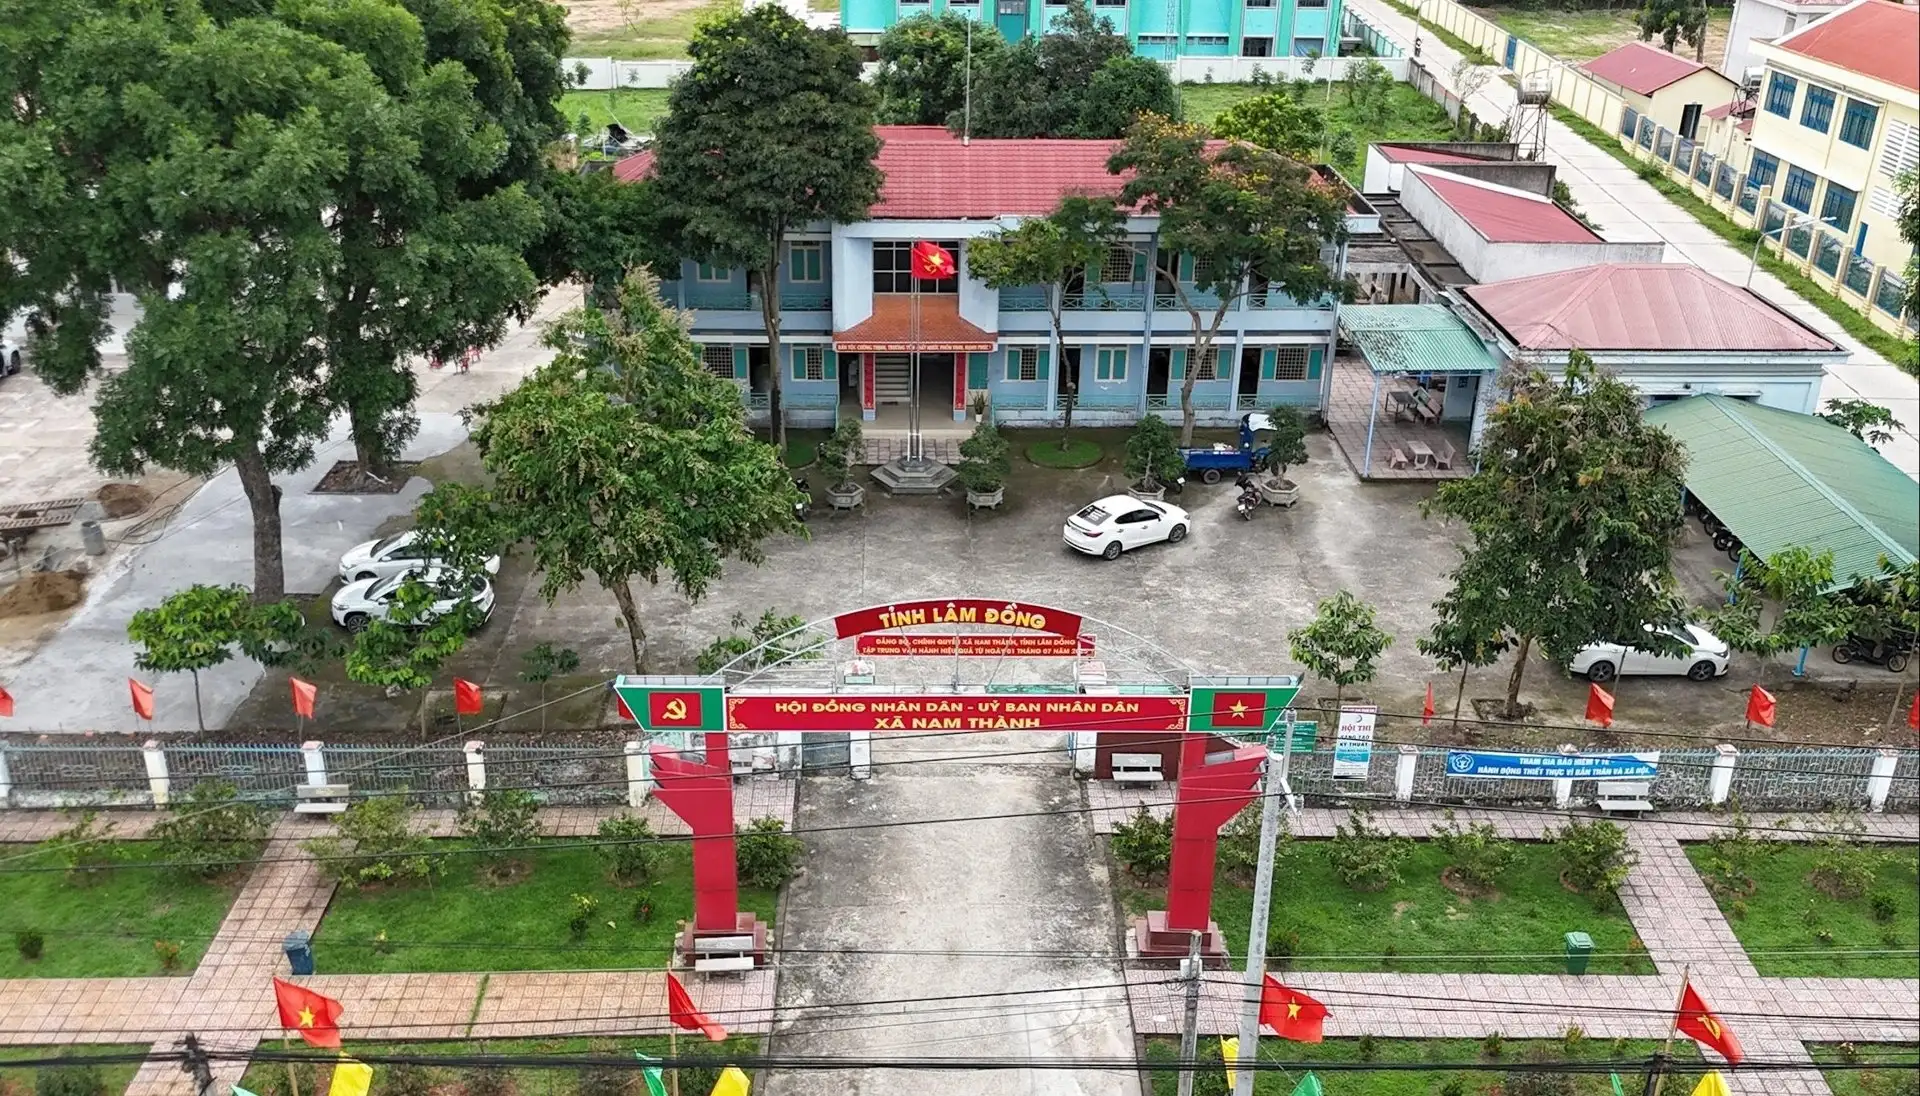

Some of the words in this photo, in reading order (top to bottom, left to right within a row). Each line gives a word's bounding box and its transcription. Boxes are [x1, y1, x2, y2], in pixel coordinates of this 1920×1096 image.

[879, 606, 925, 628] TỈNH
[933, 602, 976, 623] LÂM
[985, 602, 1046, 629] ĐỒNG
[1037, 637, 1052, 645] LÂM
[1017, 647, 1041, 655] THÁNG
[775, 700, 807, 715] HỘI
[812, 699, 866, 713] ĐỒNG
[871, 701, 921, 712] NHÂN
[926, 701, 963, 712] DÂN
[978, 699, 1001, 712] UỶ
[1005, 703, 1041, 712] BAN
[1046, 701, 1096, 712] NHÂN
[1101, 701, 1139, 712] DÂN
[873, 715, 906, 729] XÃ
[912, 718, 961, 729] NAM
[967, 715, 1040, 729] THÀNH
